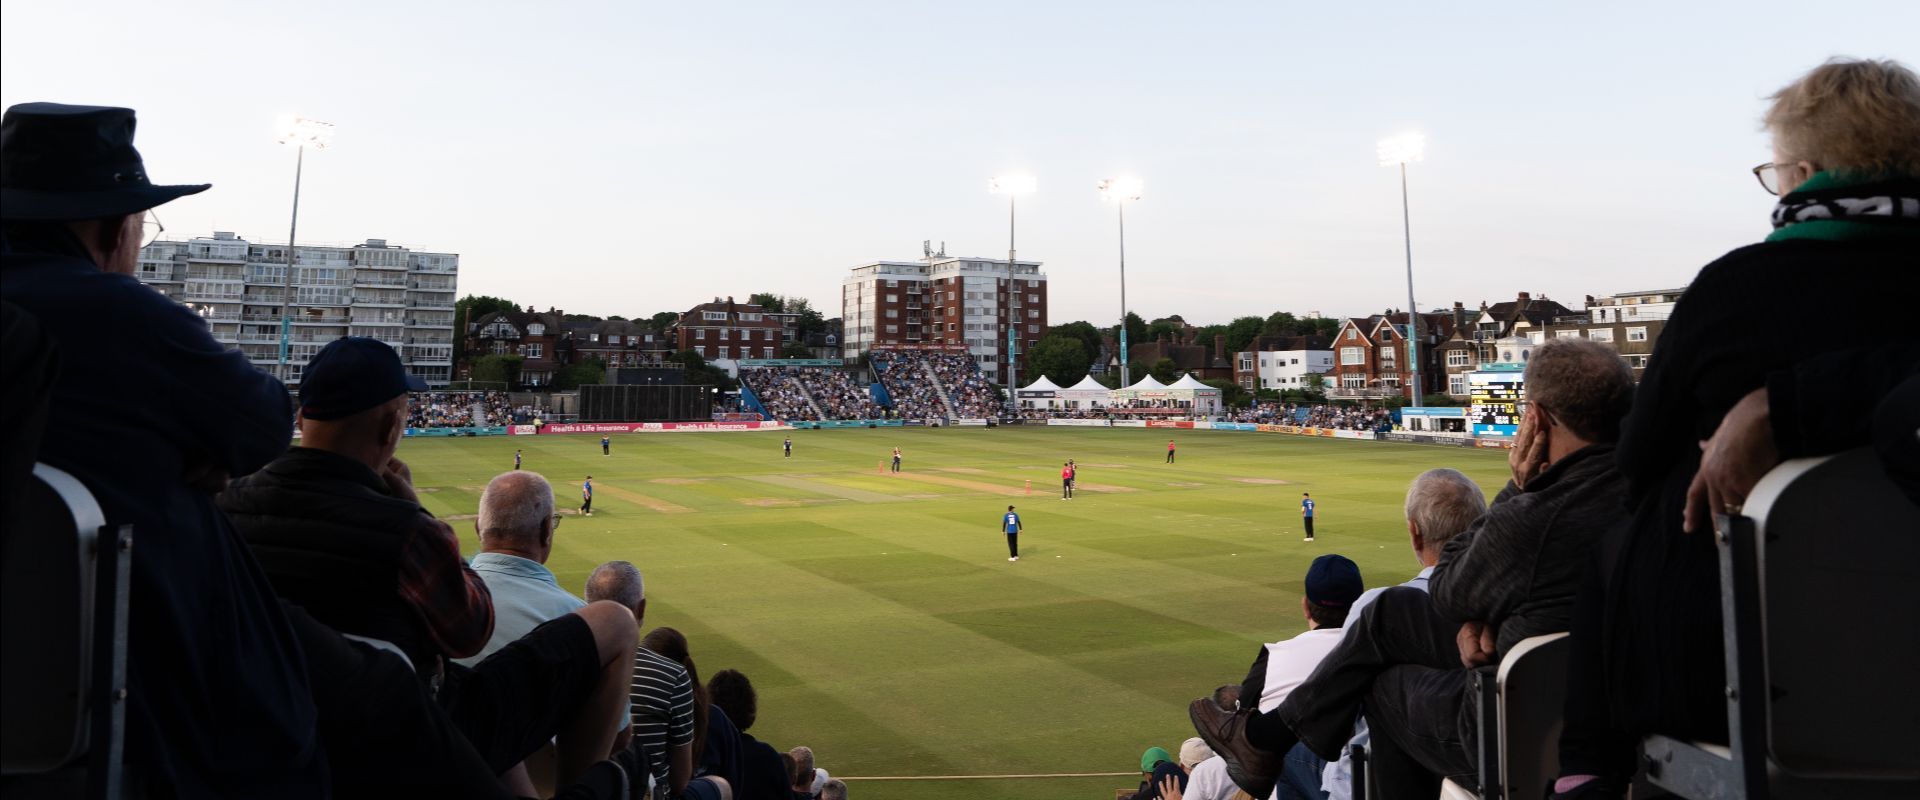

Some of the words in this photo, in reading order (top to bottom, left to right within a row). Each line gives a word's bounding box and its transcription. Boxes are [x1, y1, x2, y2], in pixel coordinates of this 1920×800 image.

[551, 425, 575, 433] Health
[581, 424, 595, 432] Life
[676, 423, 698, 431] Health
